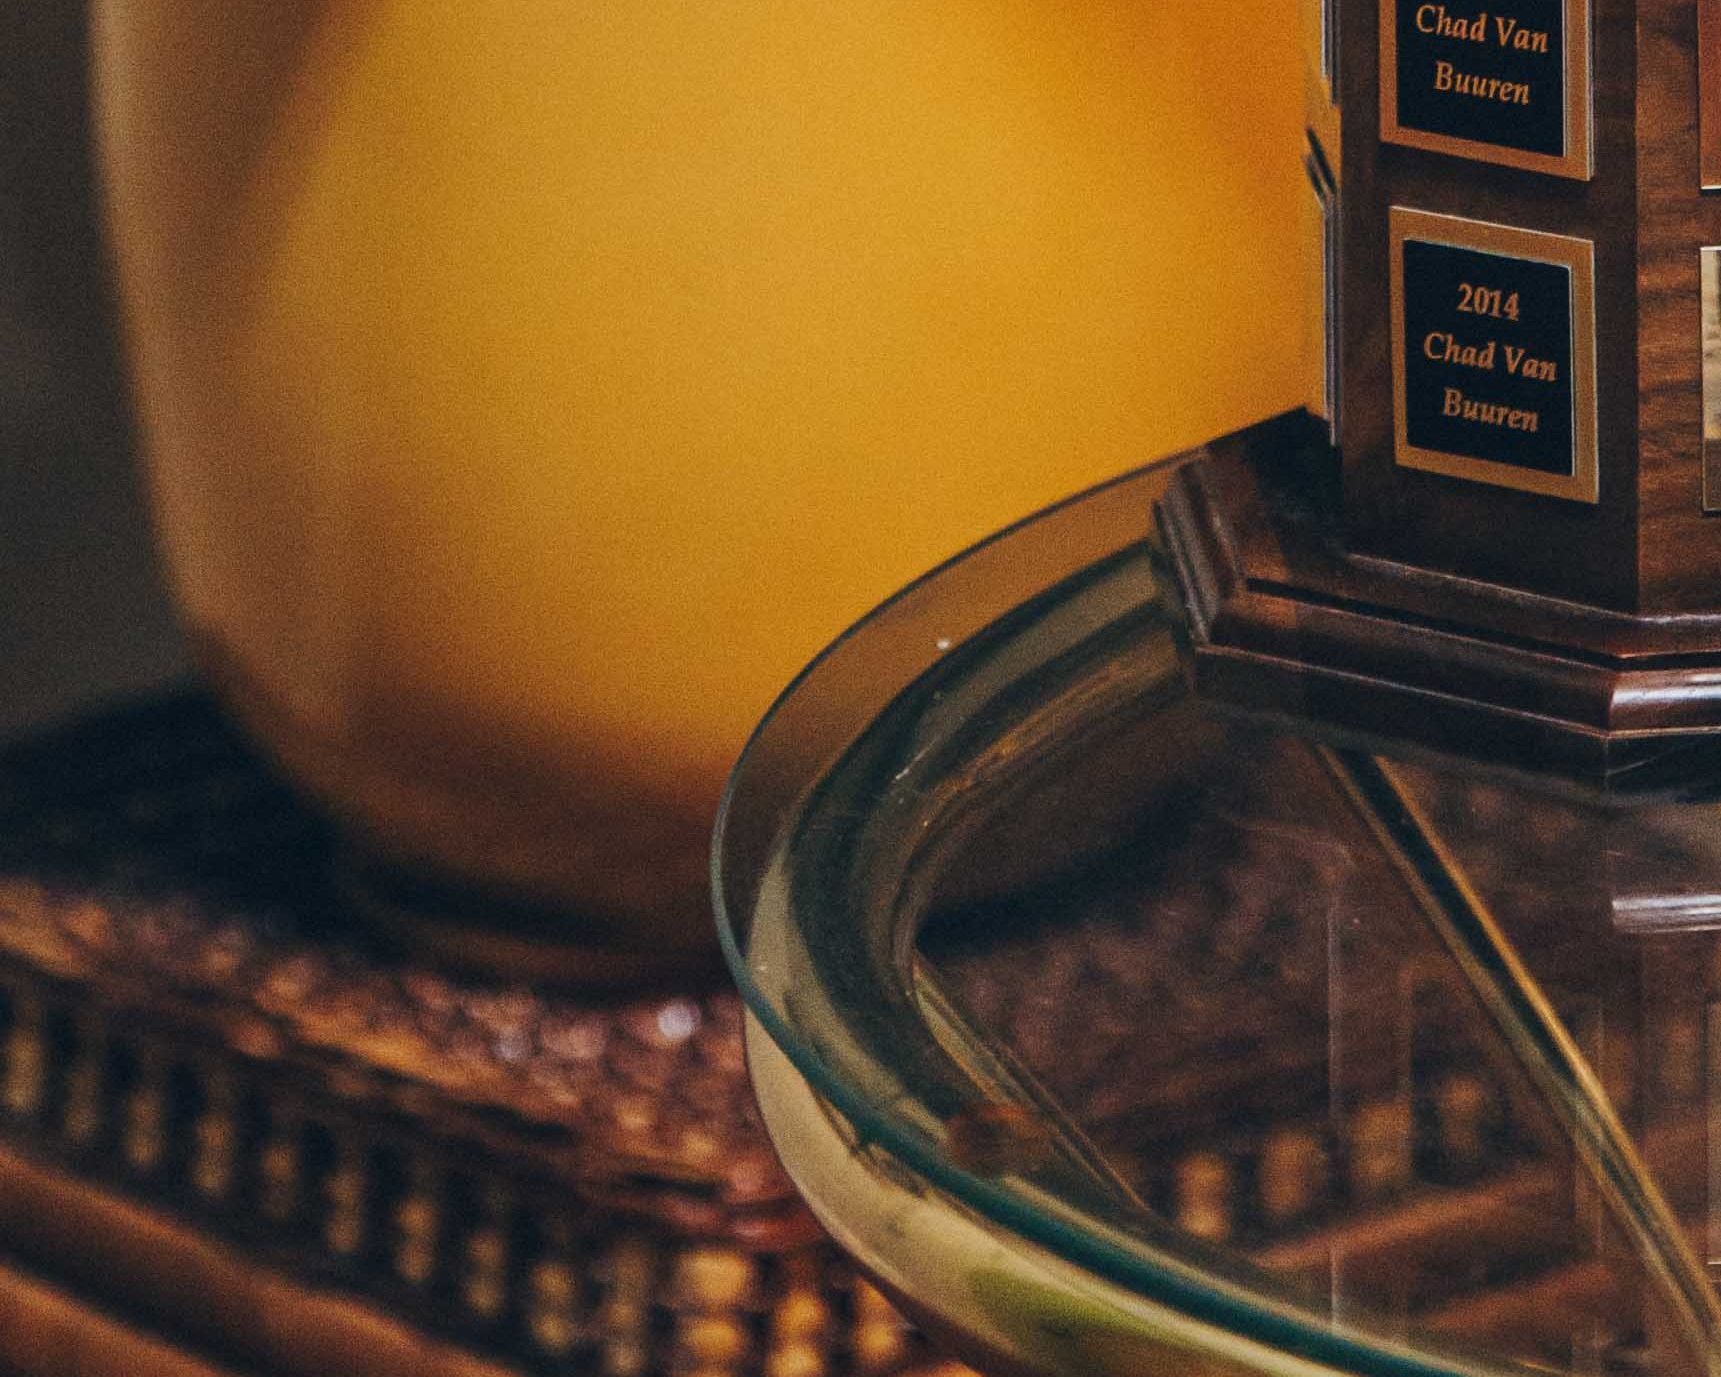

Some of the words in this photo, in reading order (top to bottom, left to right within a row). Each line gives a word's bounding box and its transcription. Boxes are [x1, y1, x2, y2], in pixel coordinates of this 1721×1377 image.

[1415, 3, 1486, 43] Chad
[1494, 15, 1549, 53] Van
[1433, 61, 1530, 105] Buuren
[1456, 282, 1521, 321] 2014
[1423, 331, 1495, 371] Chad
[1502, 344, 1558, 383] Van
[1442, 387, 1539, 433] Buuren
